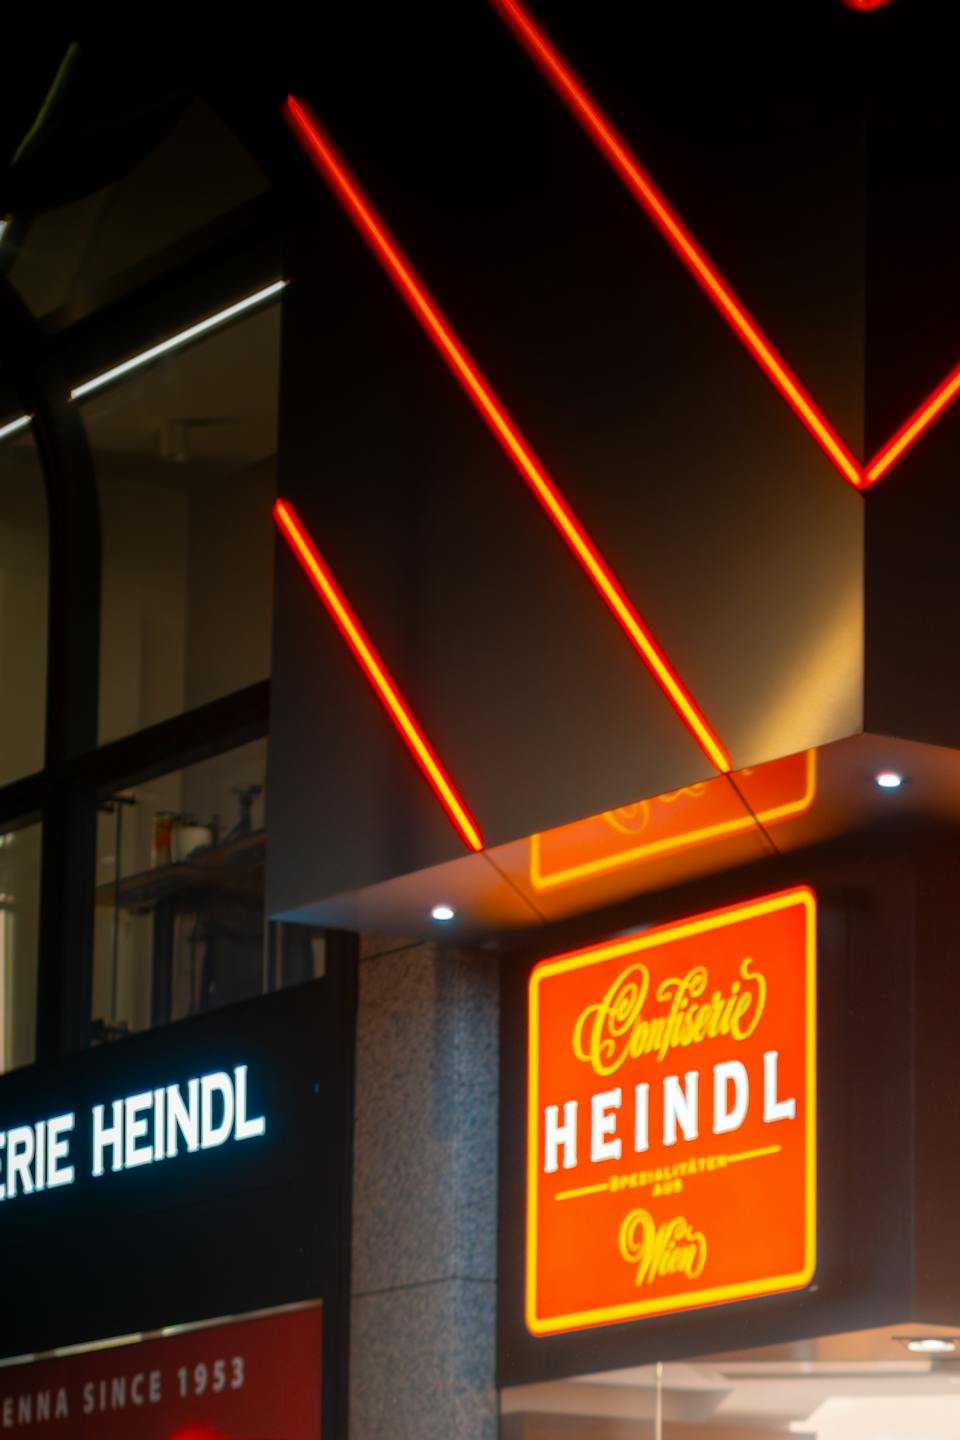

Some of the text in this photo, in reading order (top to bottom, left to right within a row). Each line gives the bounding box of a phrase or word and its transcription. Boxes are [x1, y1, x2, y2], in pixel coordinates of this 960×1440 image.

[573, 957, 767, 1077] Confiserie
[0, 1064, 266, 1200] RIE HEINDL
[544, 1050, 796, 1173] HEINDL
[652, 1178, 683, 1197] AUS
[618, 1208, 708, 1287] Wien
[2, 1356, 245, 1427] ENNA SINCE 1953
